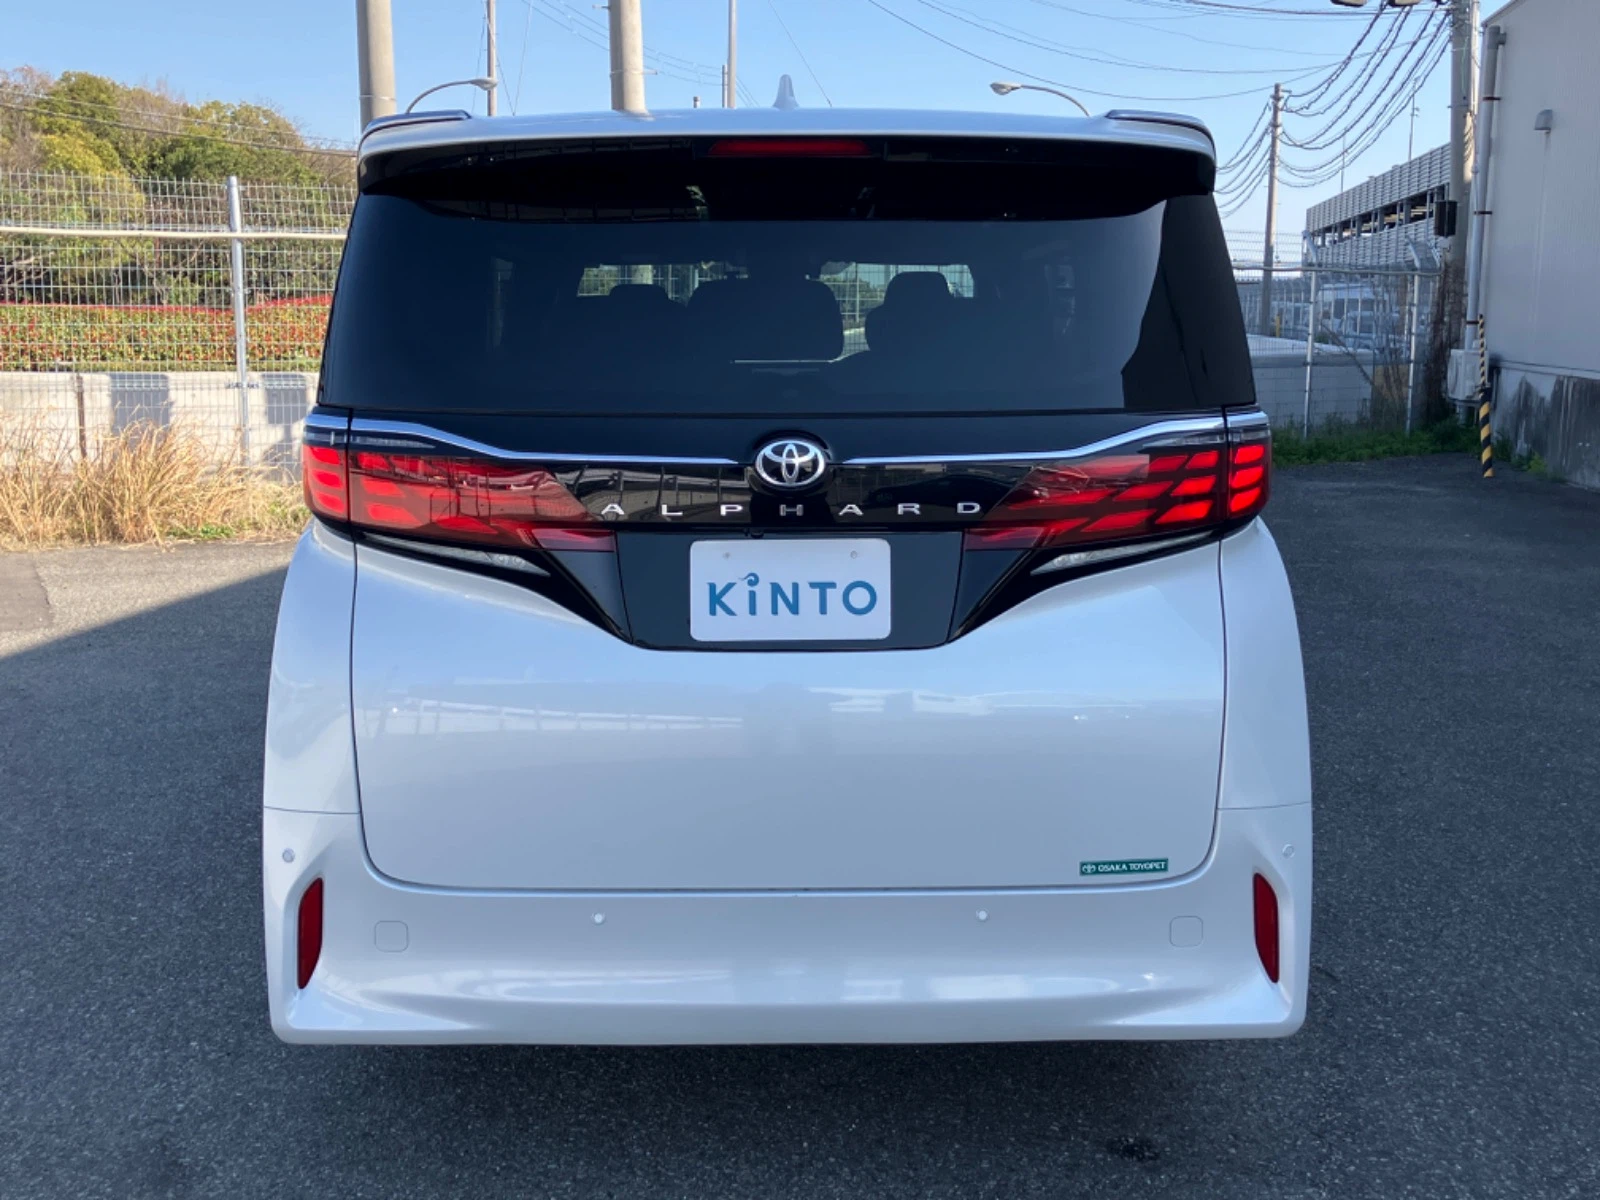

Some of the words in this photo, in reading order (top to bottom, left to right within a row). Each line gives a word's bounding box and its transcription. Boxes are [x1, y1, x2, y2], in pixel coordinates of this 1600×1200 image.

[600, 502, 981, 516] ALPHARD
[1098, 863, 1128, 873] OSAKA
[1128, 861, 1167, 871] TOYOPET
